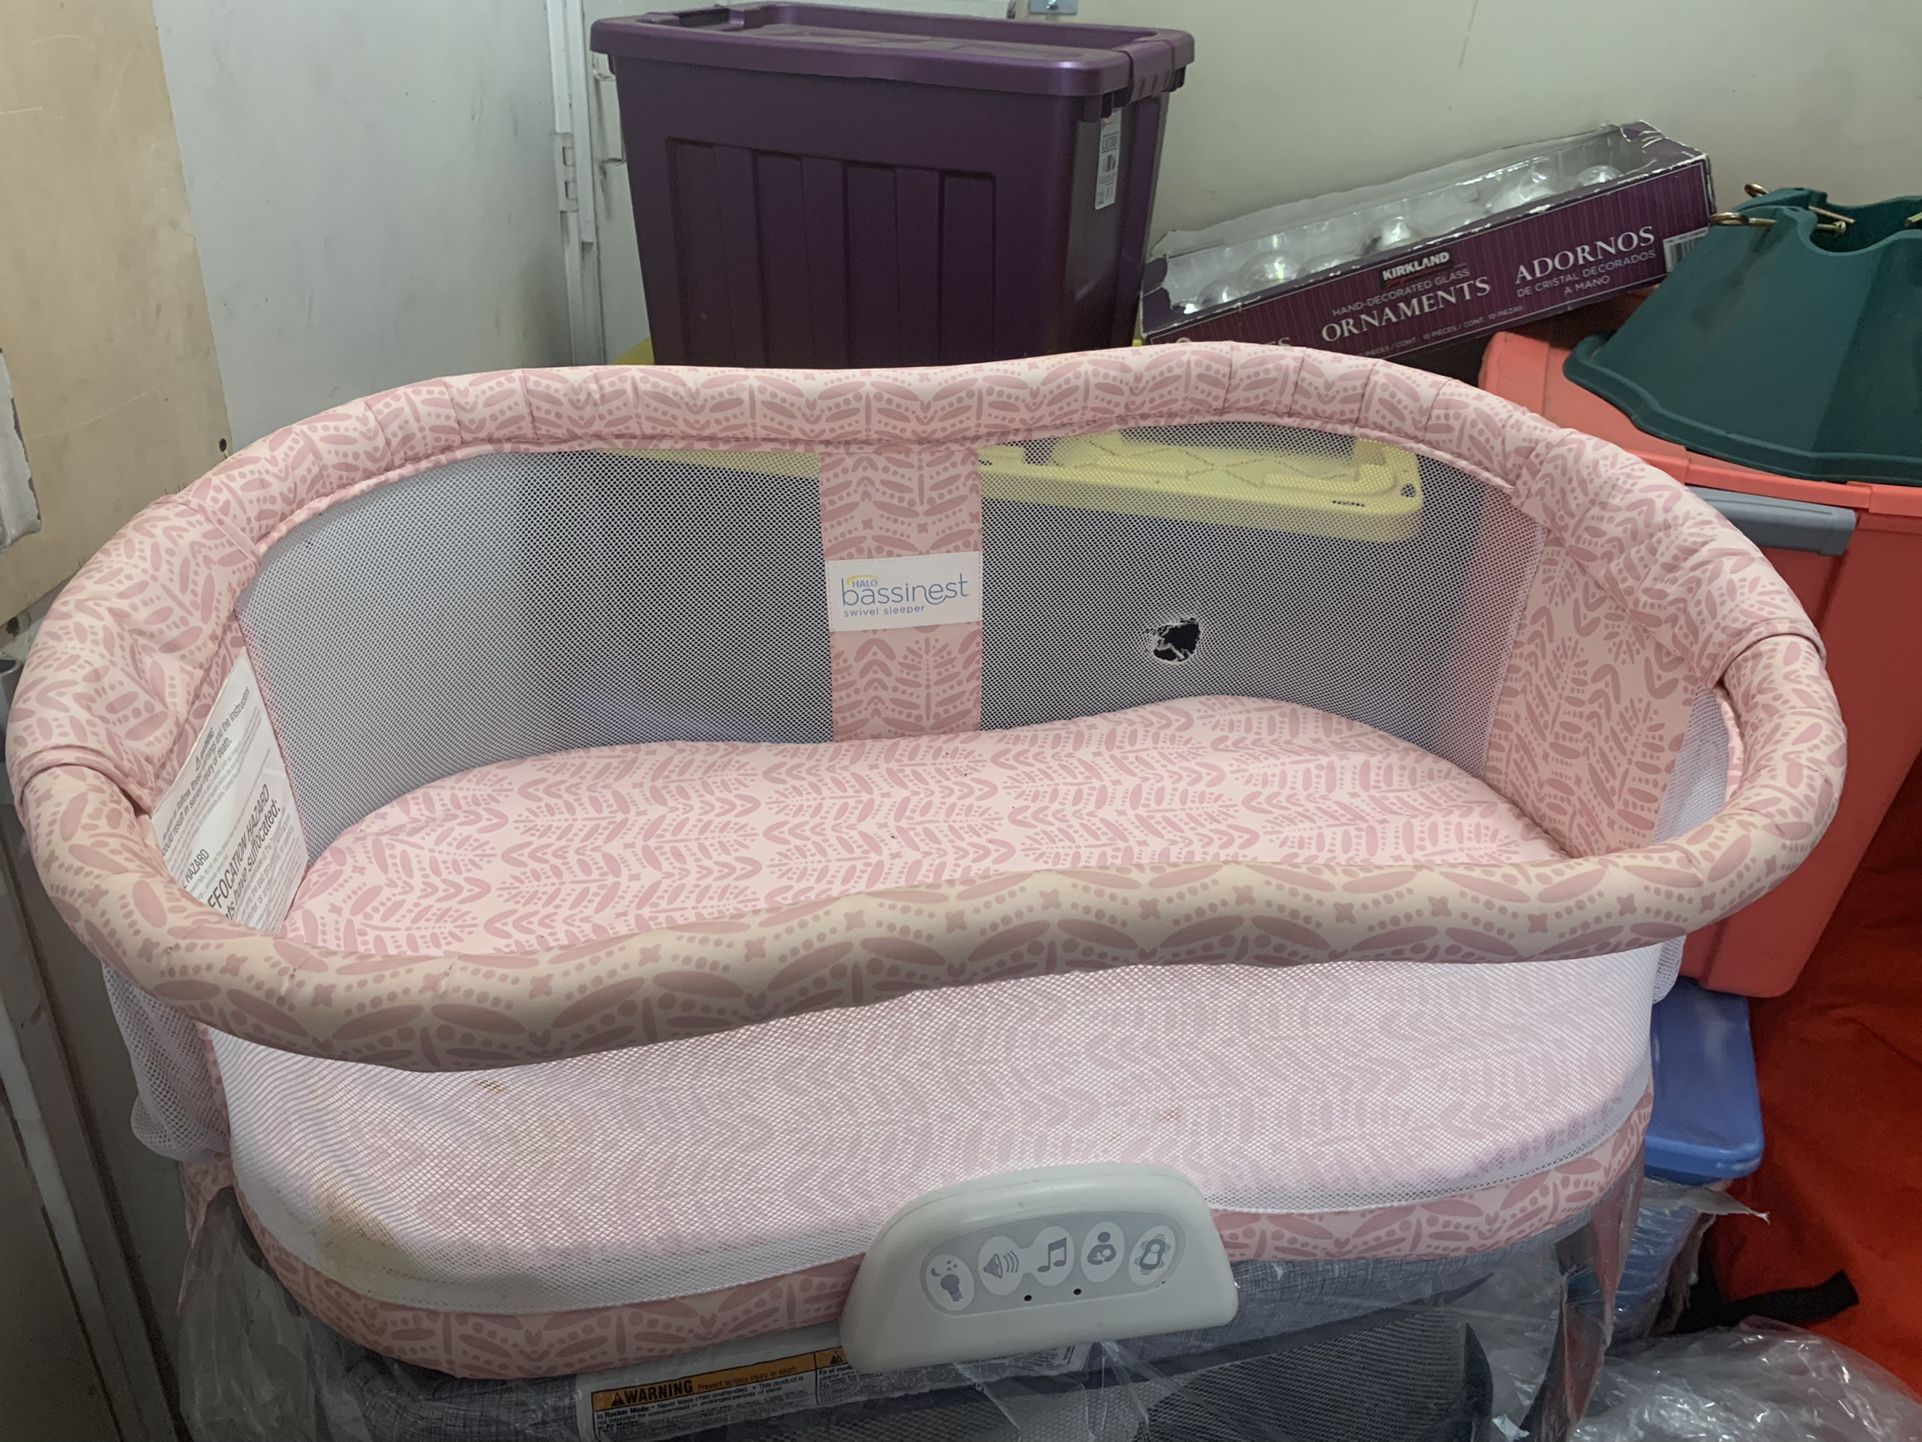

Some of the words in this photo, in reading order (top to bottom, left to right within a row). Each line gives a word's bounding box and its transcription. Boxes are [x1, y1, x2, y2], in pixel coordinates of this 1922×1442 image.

[1382, 252, 1450, 281] KIRKLAND
[1514, 225, 1655, 284] ADORNOS
[1516, 286, 1532, 298] DE
[1535, 273, 1579, 293] CRISTAL
[1582, 249, 1656, 277] DECORADOS
[1563, 286, 1573, 296] A
[1575, 275, 1611, 292] MANO
[1321, 276, 1491, 342] ORNAMENTS
[1332, 280, 1432, 316] HAND-DECORATED
[1434, 268, 1471, 286] GLASS
[841, 573, 969, 606] bassinest
[852, 579, 878, 588] HALO
[844, 607, 879, 618] swivel
[883, 604, 925, 616] sleeper
[246, 784, 269, 841] HAZARD
[247, 798, 281, 872] suffocated:
[184, 848, 210, 882] HAZARD
[624, 1379, 694, 1404] WARNING
